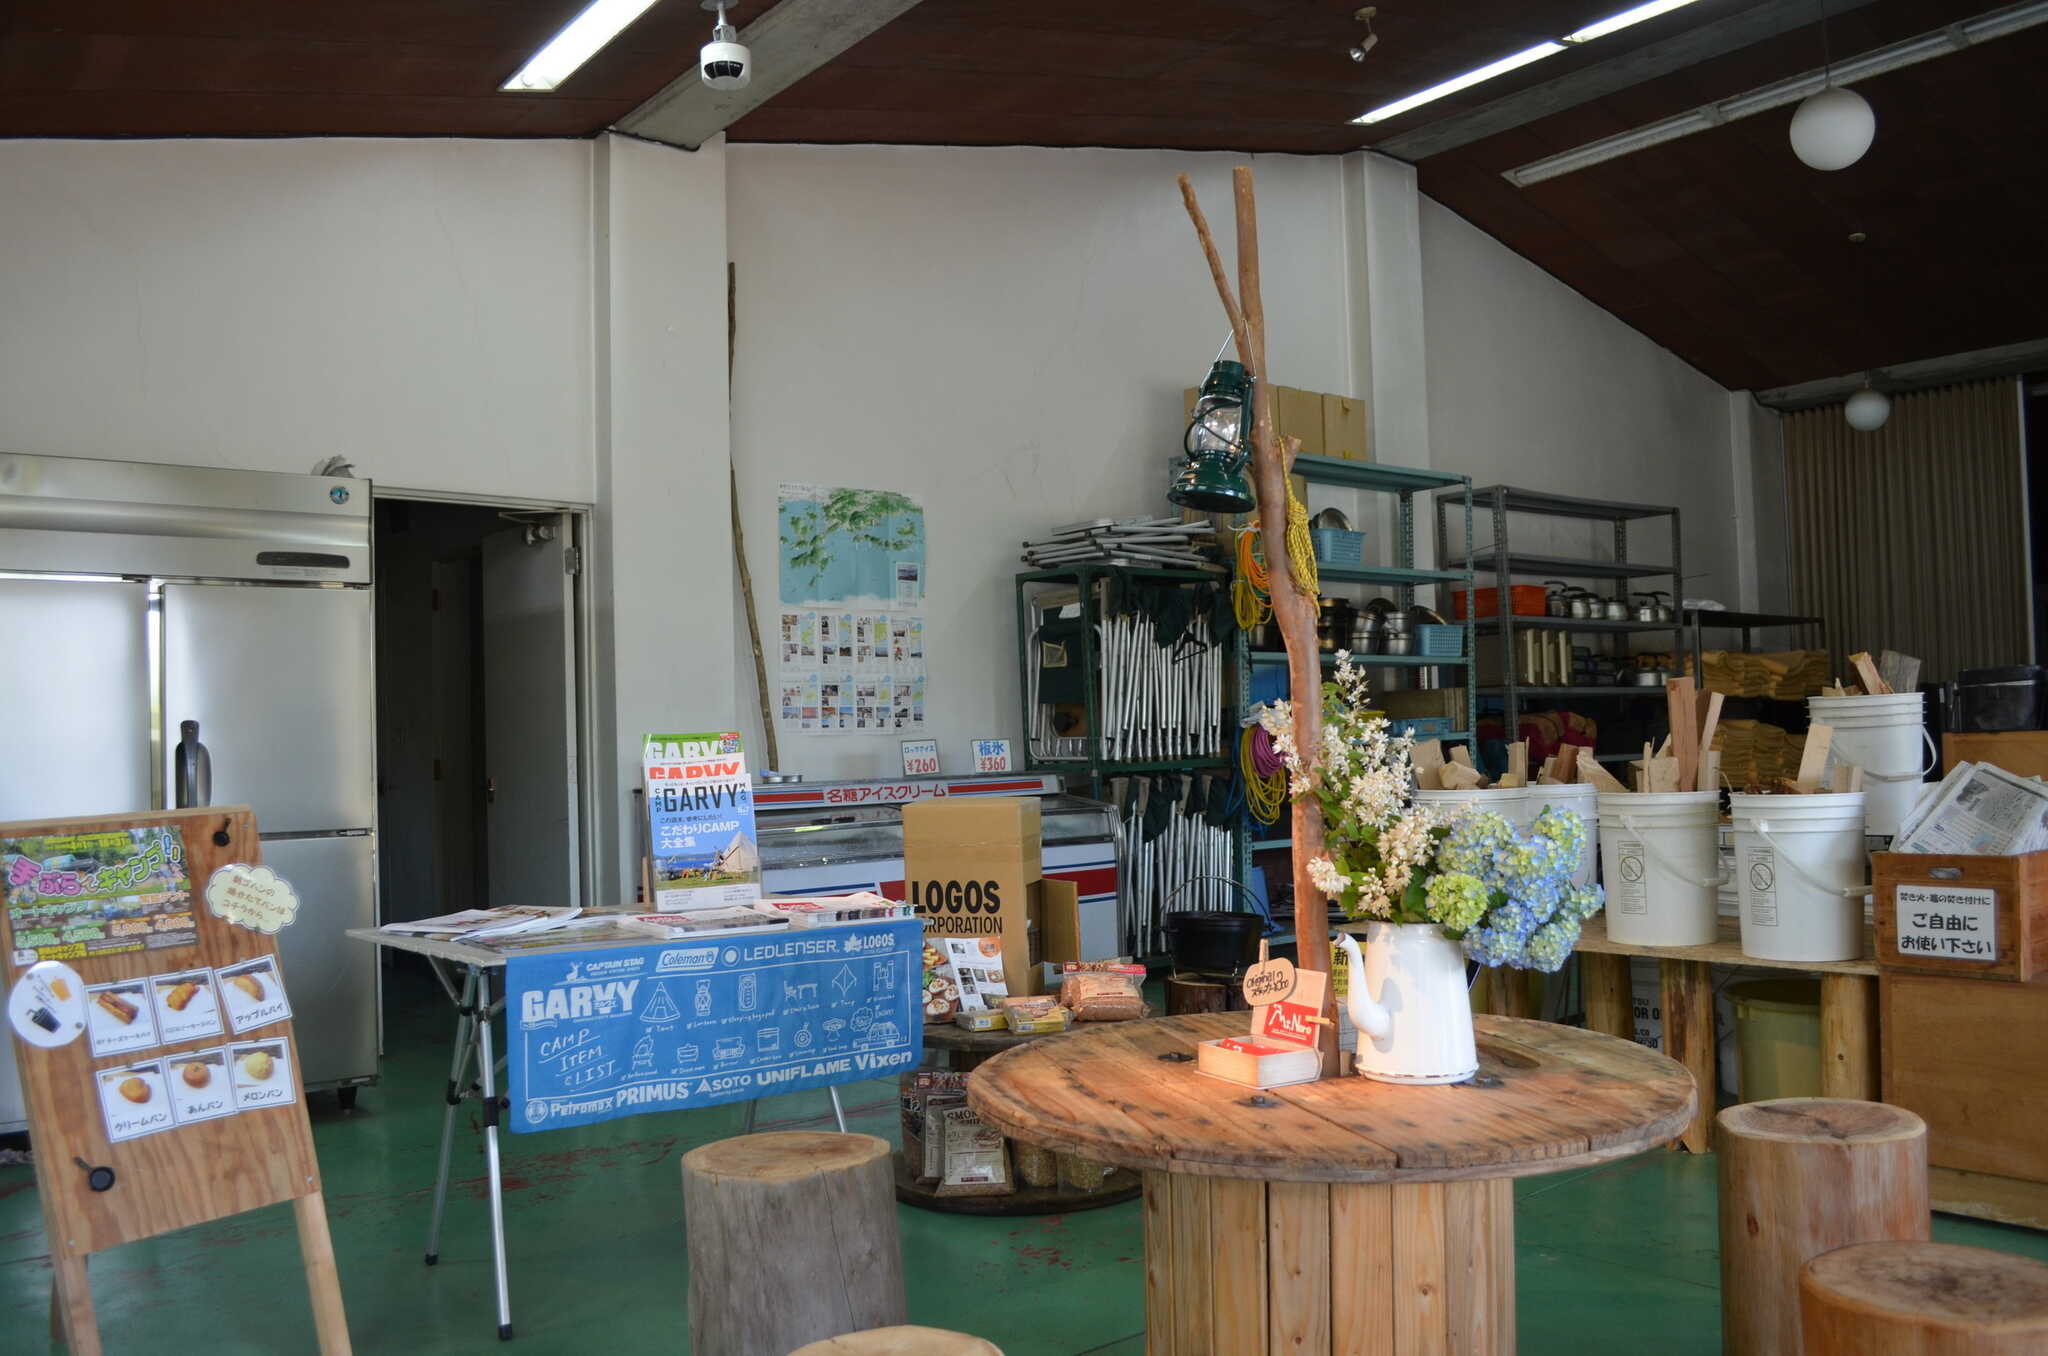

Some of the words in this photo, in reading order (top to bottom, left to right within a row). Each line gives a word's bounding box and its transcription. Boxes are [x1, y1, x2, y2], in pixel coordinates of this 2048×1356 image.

[906, 758, 937, 773] ¥260
[980, 756, 1006, 771] ¥360
[663, 783, 738, 812] GARVY
[826, 783, 947, 803] 名糖アイスクリーム
[911, 880, 1001, 914] LOGOS
[1912, 913, 1979, 931] ご自由に
[744, 939, 837, 961] LEDLENSER
[863, 932, 895, 949] LOGOS
[1901, 935, 1992, 955] お使い下さい
[662, 952, 705, 966] Coleman
[522, 979, 640, 1022] GARVY
[540, 1028, 590, 1057] CAMP
[560, 1045, 603, 1073] ITEM
[854, 1050, 913, 1071] Vixen
[756, 1058, 852, 1086] UNIFLAME
[243, 1088, 284, 1102] メロンパン
[616, 1081, 690, 1108] PRIMUS
[550, 1096, 614, 1118] Petromax
[114, 1113, 168, 1132] クリームパン
